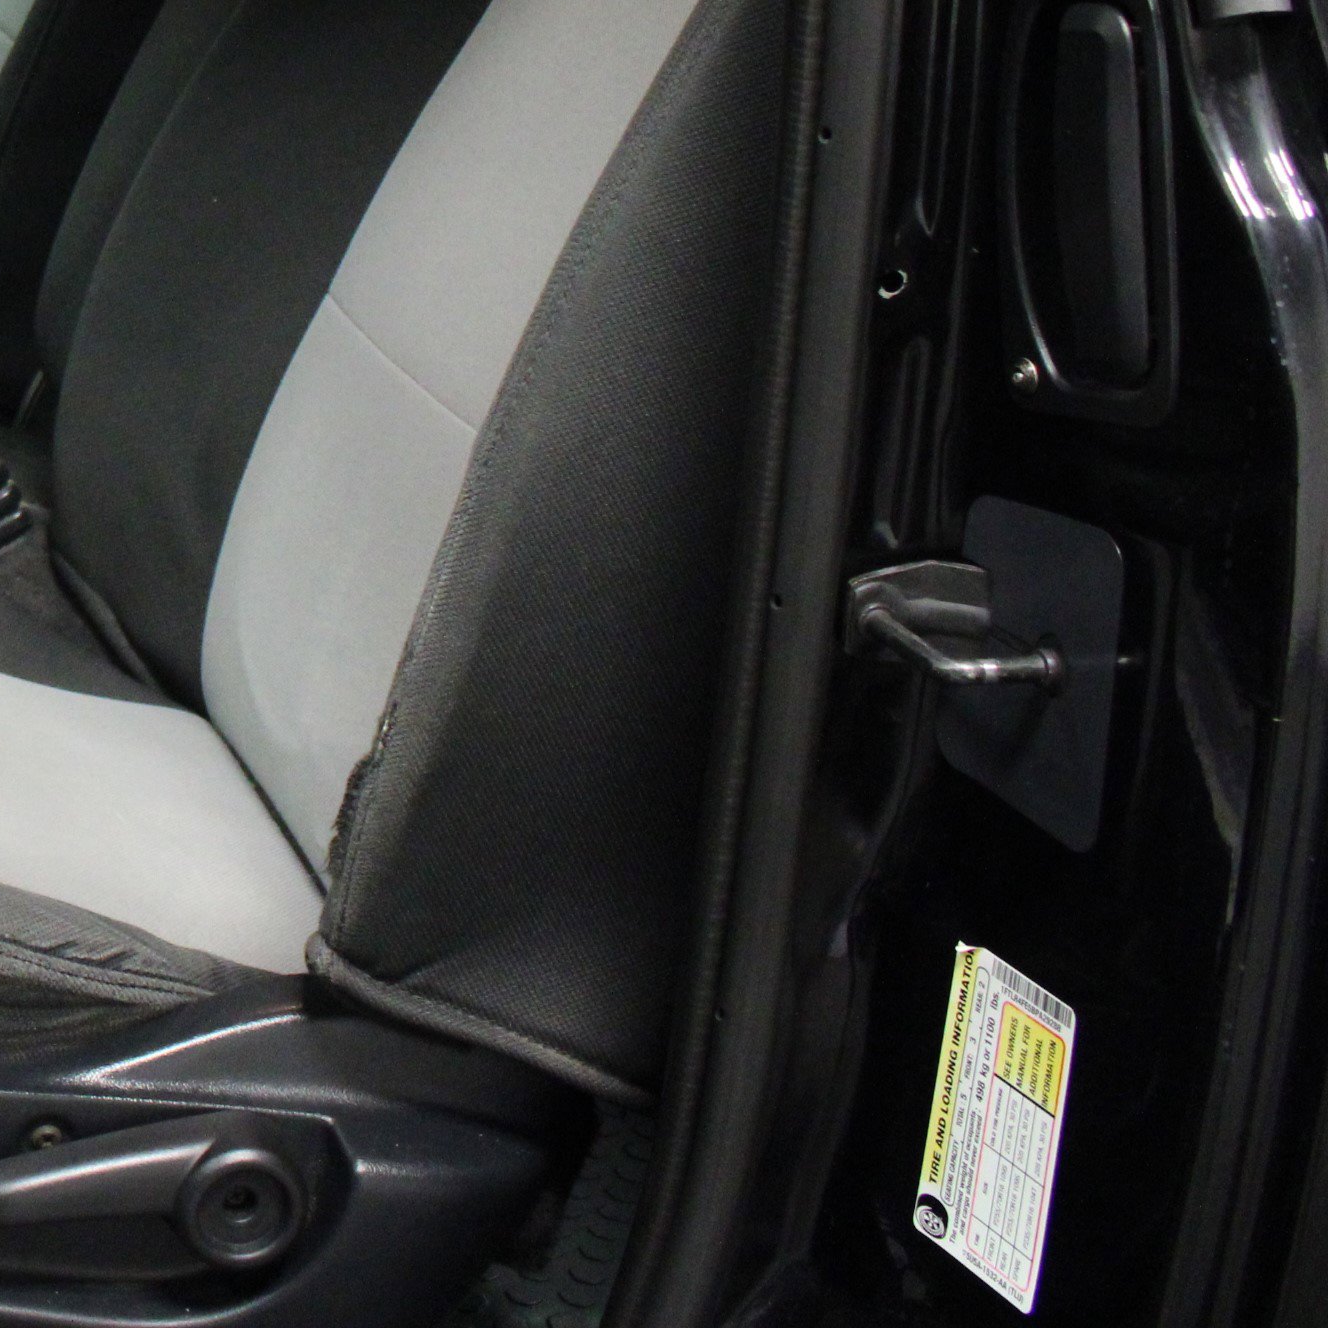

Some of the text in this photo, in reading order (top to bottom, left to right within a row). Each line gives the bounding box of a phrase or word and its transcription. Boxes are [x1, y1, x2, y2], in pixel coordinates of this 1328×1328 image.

[983, 1048, 990, 1060] or
[984, 1017, 995, 1046] 1100
[1003, 1017, 1018, 1079] SEE OWNERS
[1016, 1025, 1030, 1088] MANUAL FOR
[976, 1081, 985, 1103] 498
[980, 1062, 988, 1078] kg
[1029, 1039, 1043, 1096] ADDITIONAL
[1041, 1040, 1057, 1108] INFORMATION
[929, 1151, 940, 1186] TIRE
[937, 1117, 946, 1148] AND
[942, 1050, 957, 1115] LOADING
[945, 1140, 958, 1201] SEATING CAPACITY
[953, 1190, 962, 1228] combined
[959, 1162, 968, 1189] weight
[965, 1111, 976, 1151] occupants
[965, 1169, 973, 1194] should
